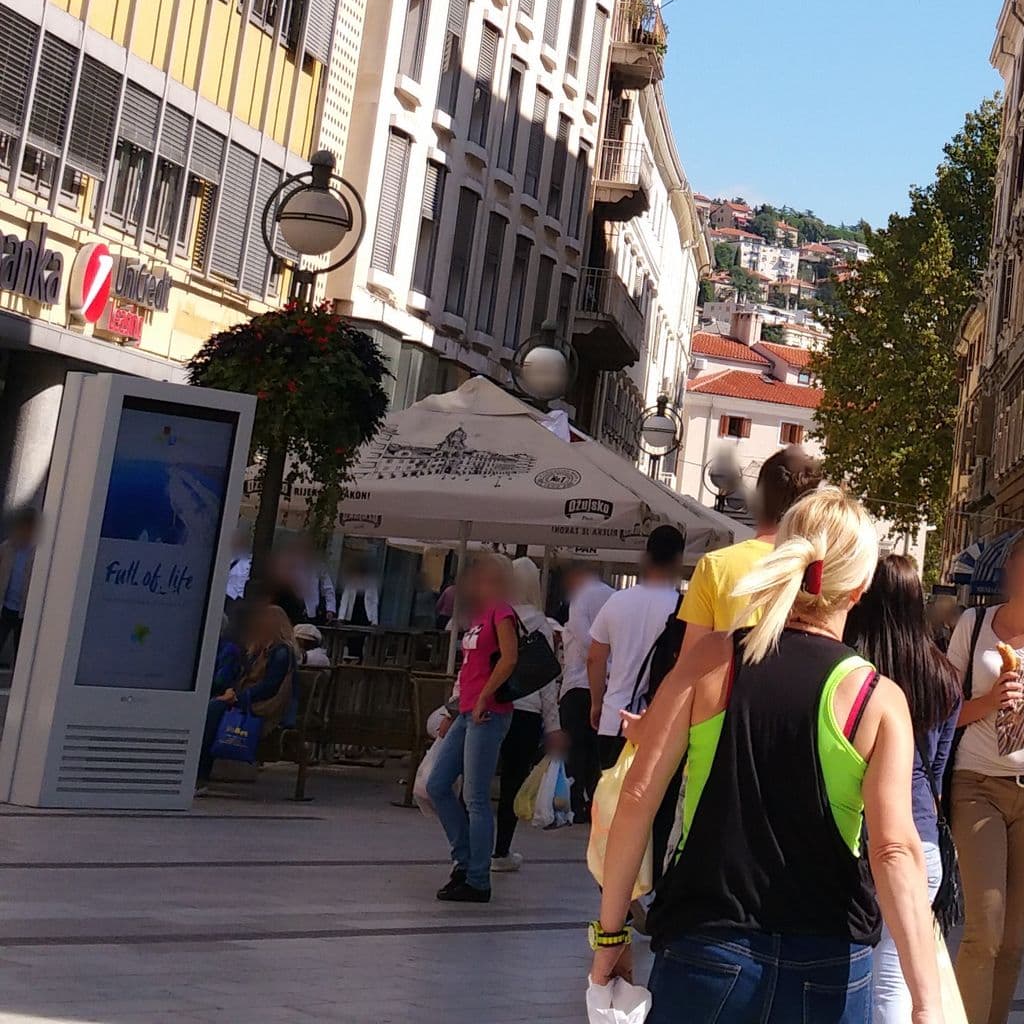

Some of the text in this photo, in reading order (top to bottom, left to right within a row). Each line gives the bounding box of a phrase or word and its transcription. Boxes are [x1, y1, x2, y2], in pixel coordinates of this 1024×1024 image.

[0, 222, 64, 305] anka
[115, 255, 172, 312] UniCredit
[143, 562, 161, 593] of
[168, 564, 193, 594] life
